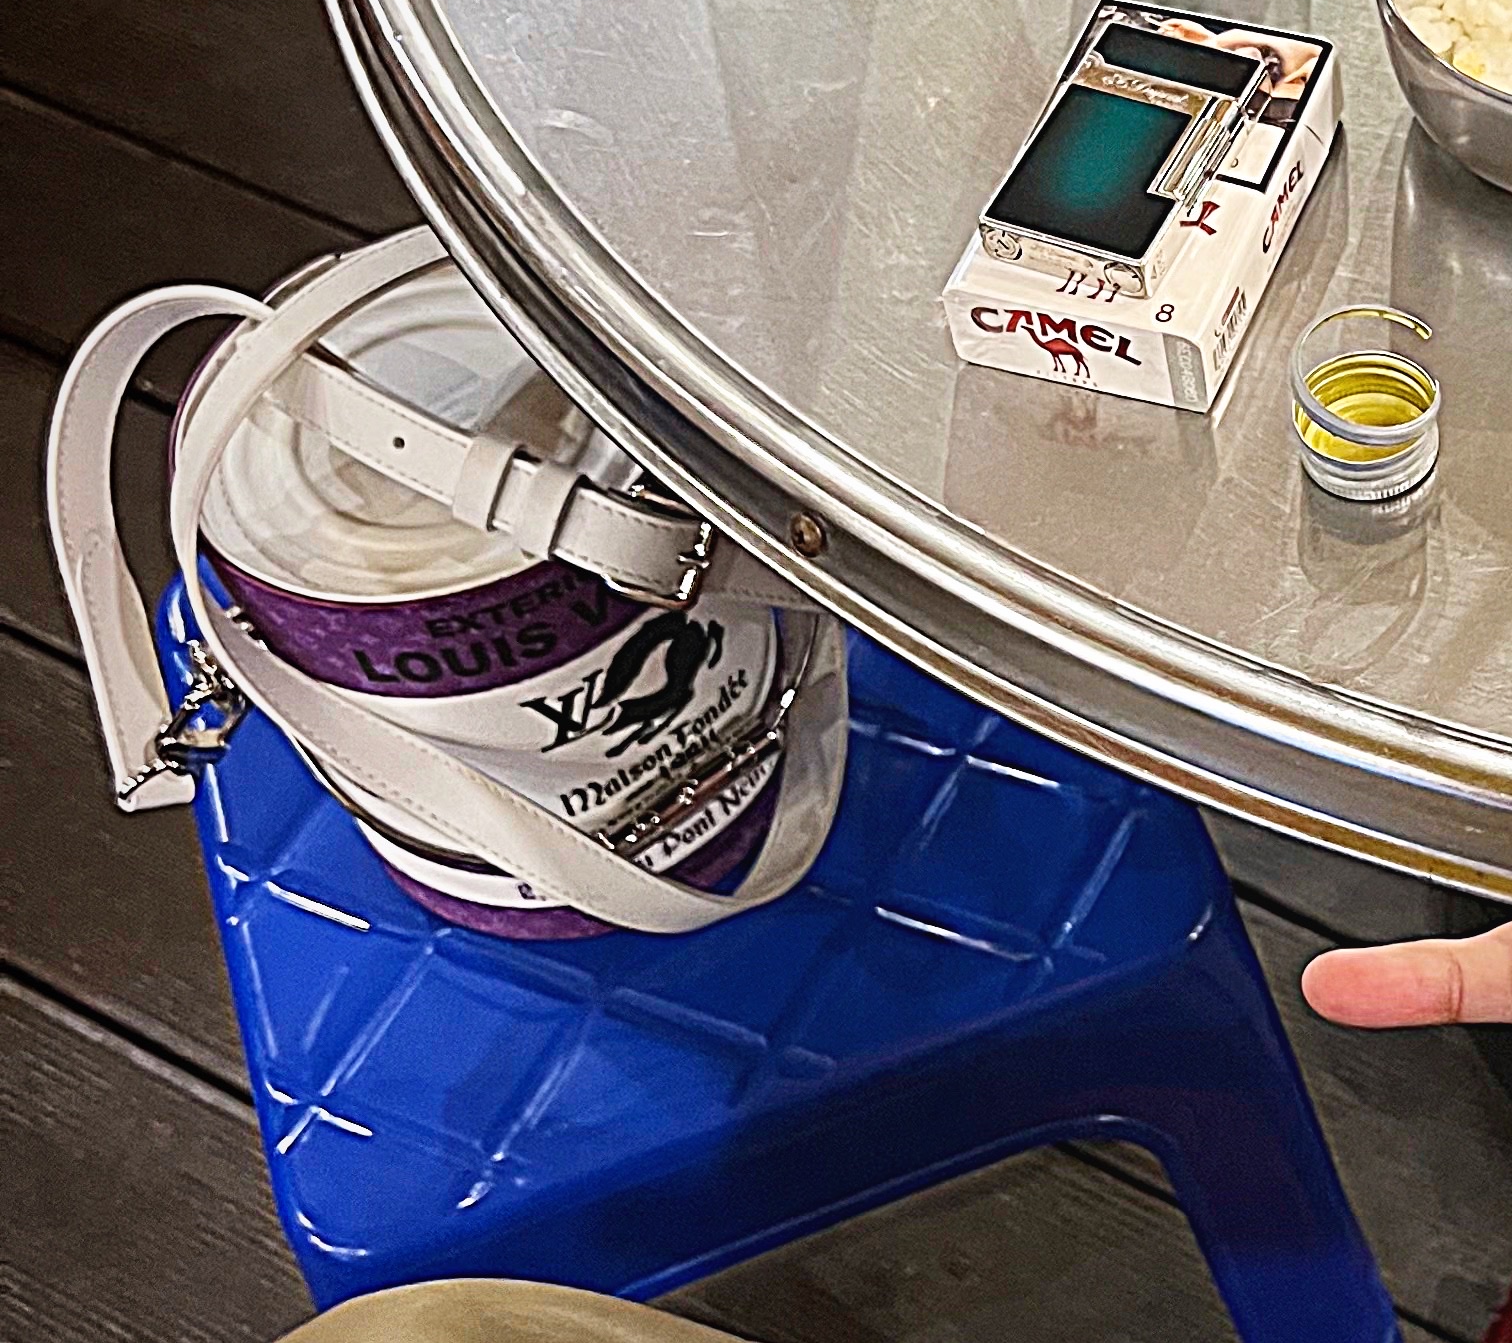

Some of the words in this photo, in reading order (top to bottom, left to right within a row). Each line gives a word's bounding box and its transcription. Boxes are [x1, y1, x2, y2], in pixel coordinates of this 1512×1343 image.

[1262, 160, 1304, 254] CAMEL
[970, 306, 1143, 367] CAMEL
[1154, 303, 1175, 323] 8
[354, 622, 558, 684] LOUIS
